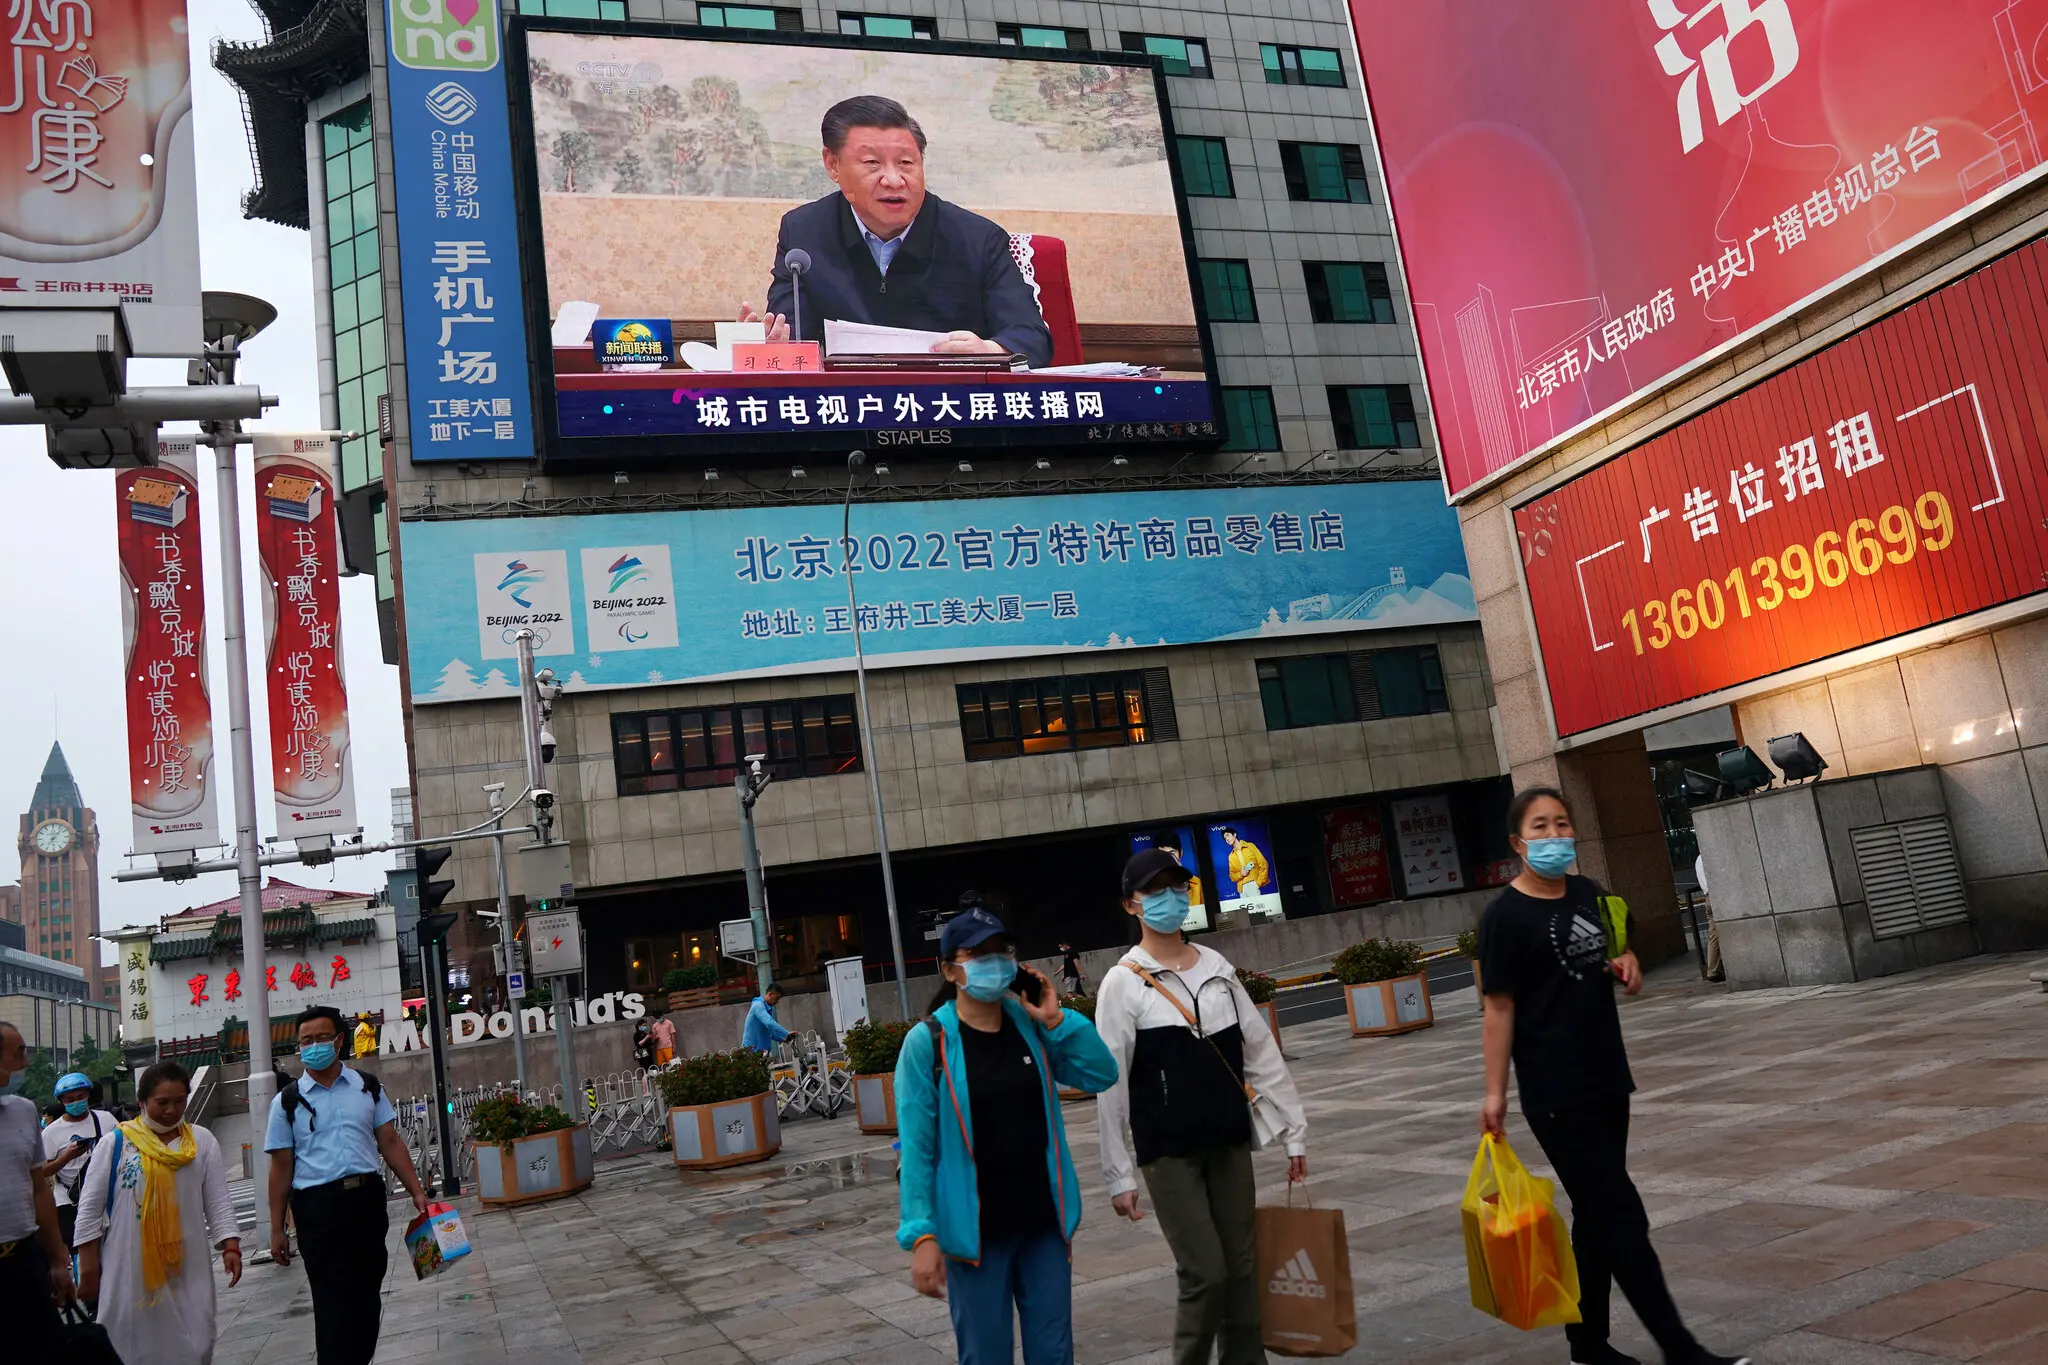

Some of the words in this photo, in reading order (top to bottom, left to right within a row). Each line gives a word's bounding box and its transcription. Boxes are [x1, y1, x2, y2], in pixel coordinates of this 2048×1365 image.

[431, 130, 447, 169] China
[451, 131, 480, 220] 中国移动
[433, 173, 452, 219] Mobile
[1517, 287, 1678, 411] 北京市人民政府
[1689, 124, 1943, 303] 中央广播电视总台
[35, 280, 153, 295] 王府井书店
[431, 240, 497, 384] 手机广场
[605, 341, 662, 355] 新闻联播
[744, 355, 809, 371] 习近平
[428, 398, 512, 418] 工美大厦
[697, 390, 1105, 428] 城市电视户外大屏联播网
[429, 420, 515, 442] 地下一层
[877, 429, 952, 446] STAPLES
[1639, 410, 1885, 564] 广告位招租
[736, 509, 1345, 582] 北京2022官方特许商品零售店
[1621, 490, 1955, 656] 13601396699
[593, 598, 633, 612] BEIJING
[637, 596, 667, 606] 2022
[638, 609, 656, 617] GAMES
[487, 614, 528, 628] BEIJING
[532, 613, 564, 624] 2022
[1268, 1279, 1326, 1299] adidas
